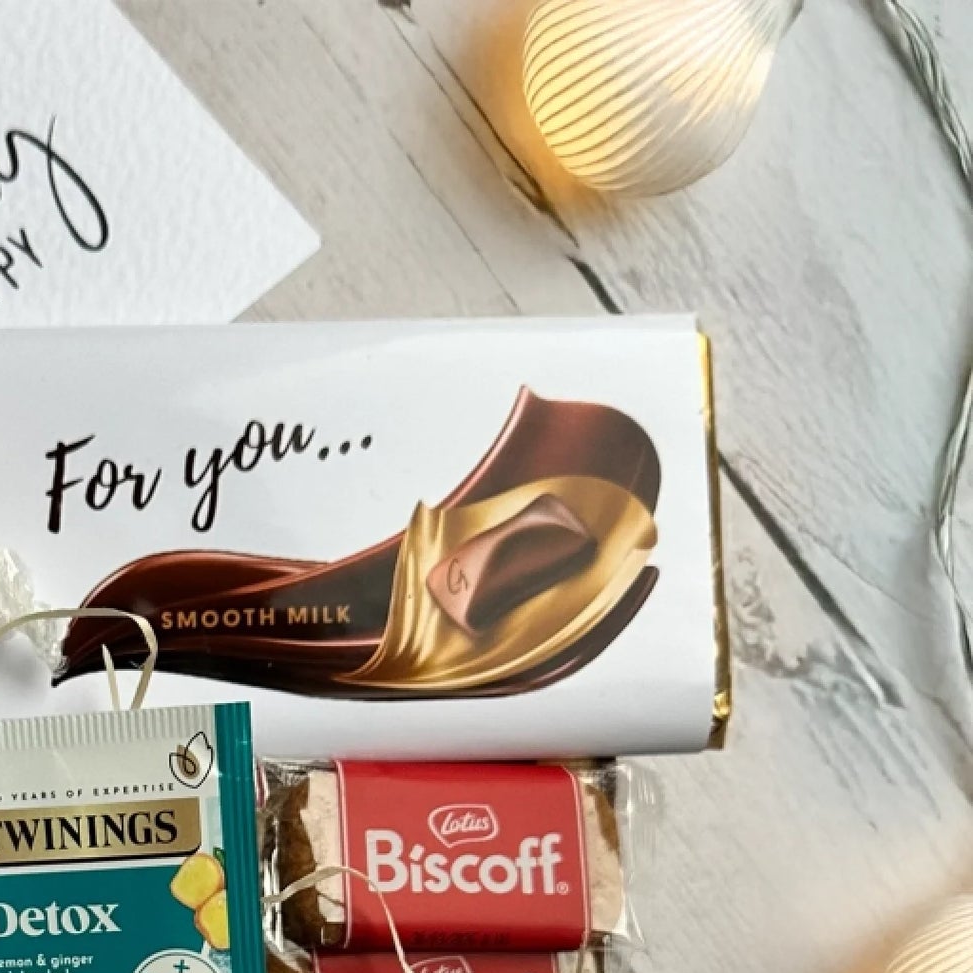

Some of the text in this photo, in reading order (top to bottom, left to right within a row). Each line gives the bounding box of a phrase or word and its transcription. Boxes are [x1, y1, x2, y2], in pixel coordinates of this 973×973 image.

[45, 419, 373, 534] For you...
[161, 606, 352, 630] SMOOTH MILK
[11, 791, 56, 801] YEARS
[66, 789, 83, 798] OF
[93, 782, 175, 797] EXPERTISE
[440, 810, 490, 835] Lotus
[365, 829, 562, 894] Biscoff
[36, 953, 46, 966] &
[50, 953, 93, 969] ginger
